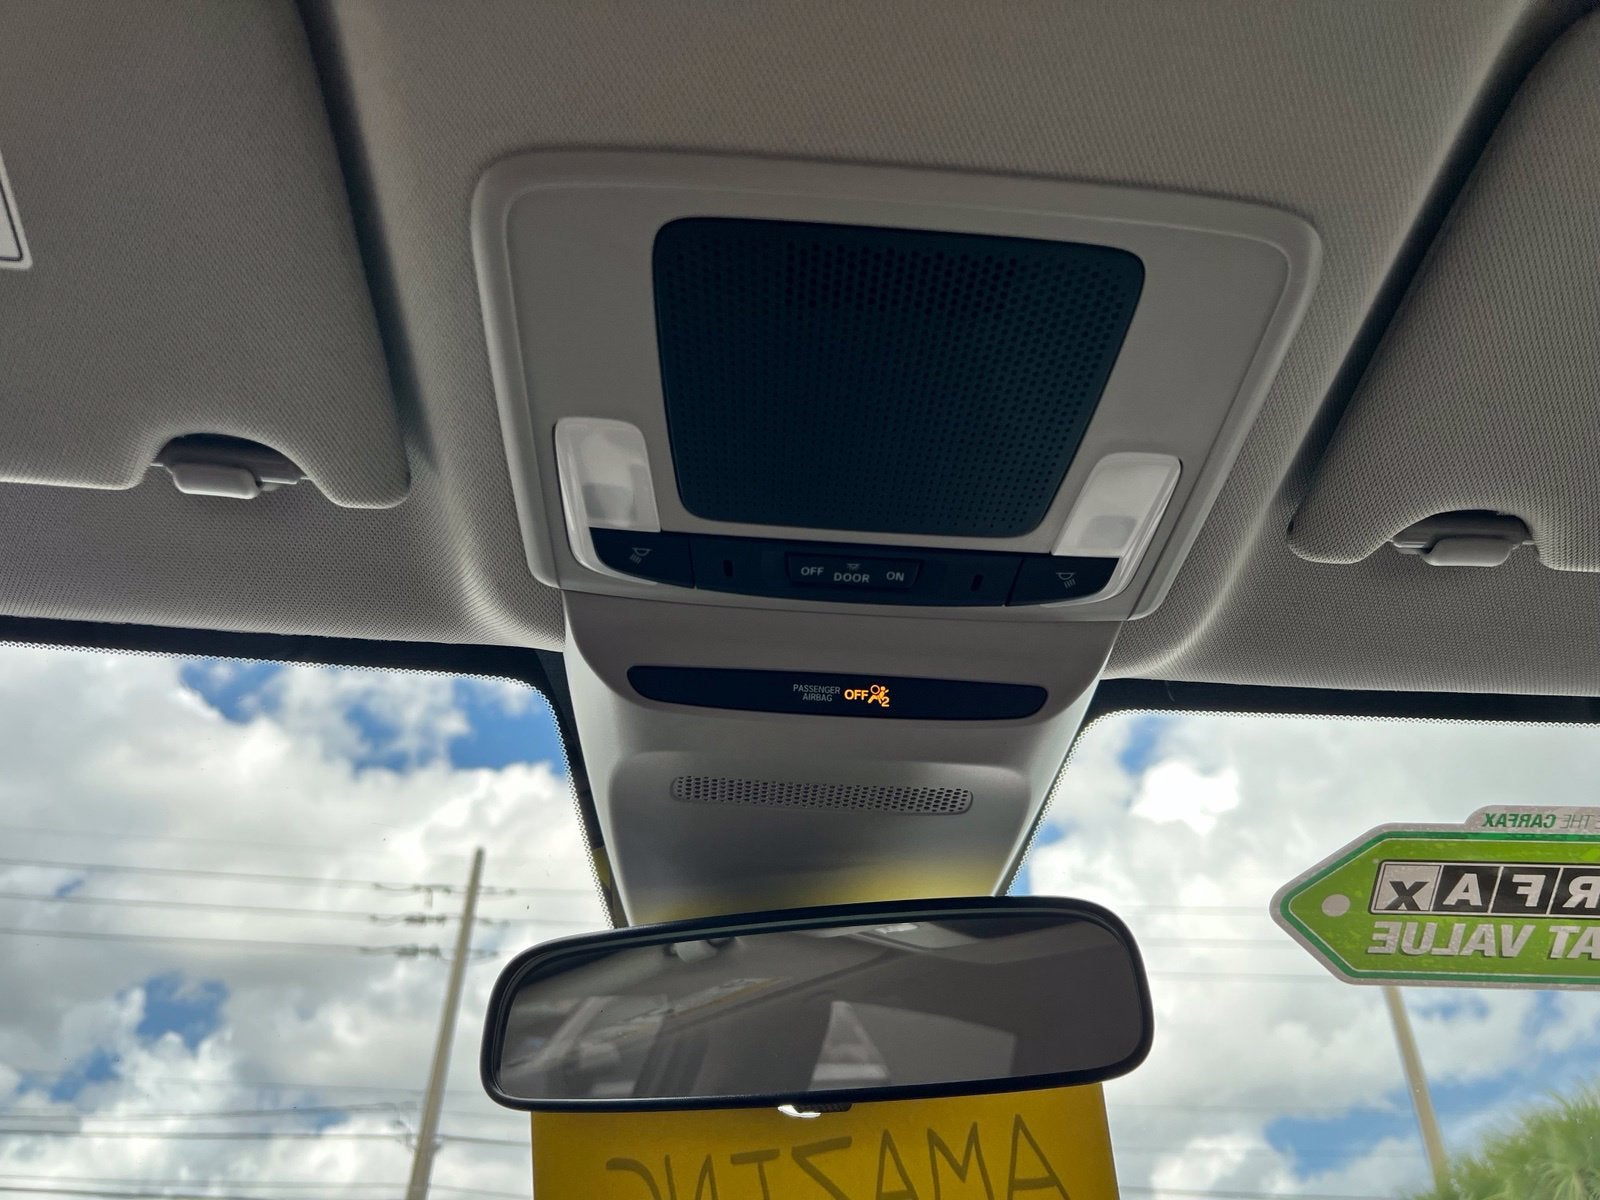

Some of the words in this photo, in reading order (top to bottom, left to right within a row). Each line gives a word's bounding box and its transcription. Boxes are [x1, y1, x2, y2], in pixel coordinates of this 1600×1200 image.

[801, 566, 824, 576] OFF
[833, 572, 870, 583] DOOR
[886, 571, 905, 582] ON
[793, 683, 841, 695] PASSENGER
[844, 689, 869, 700] OFF
[802, 692, 833, 702] AIRBAG
